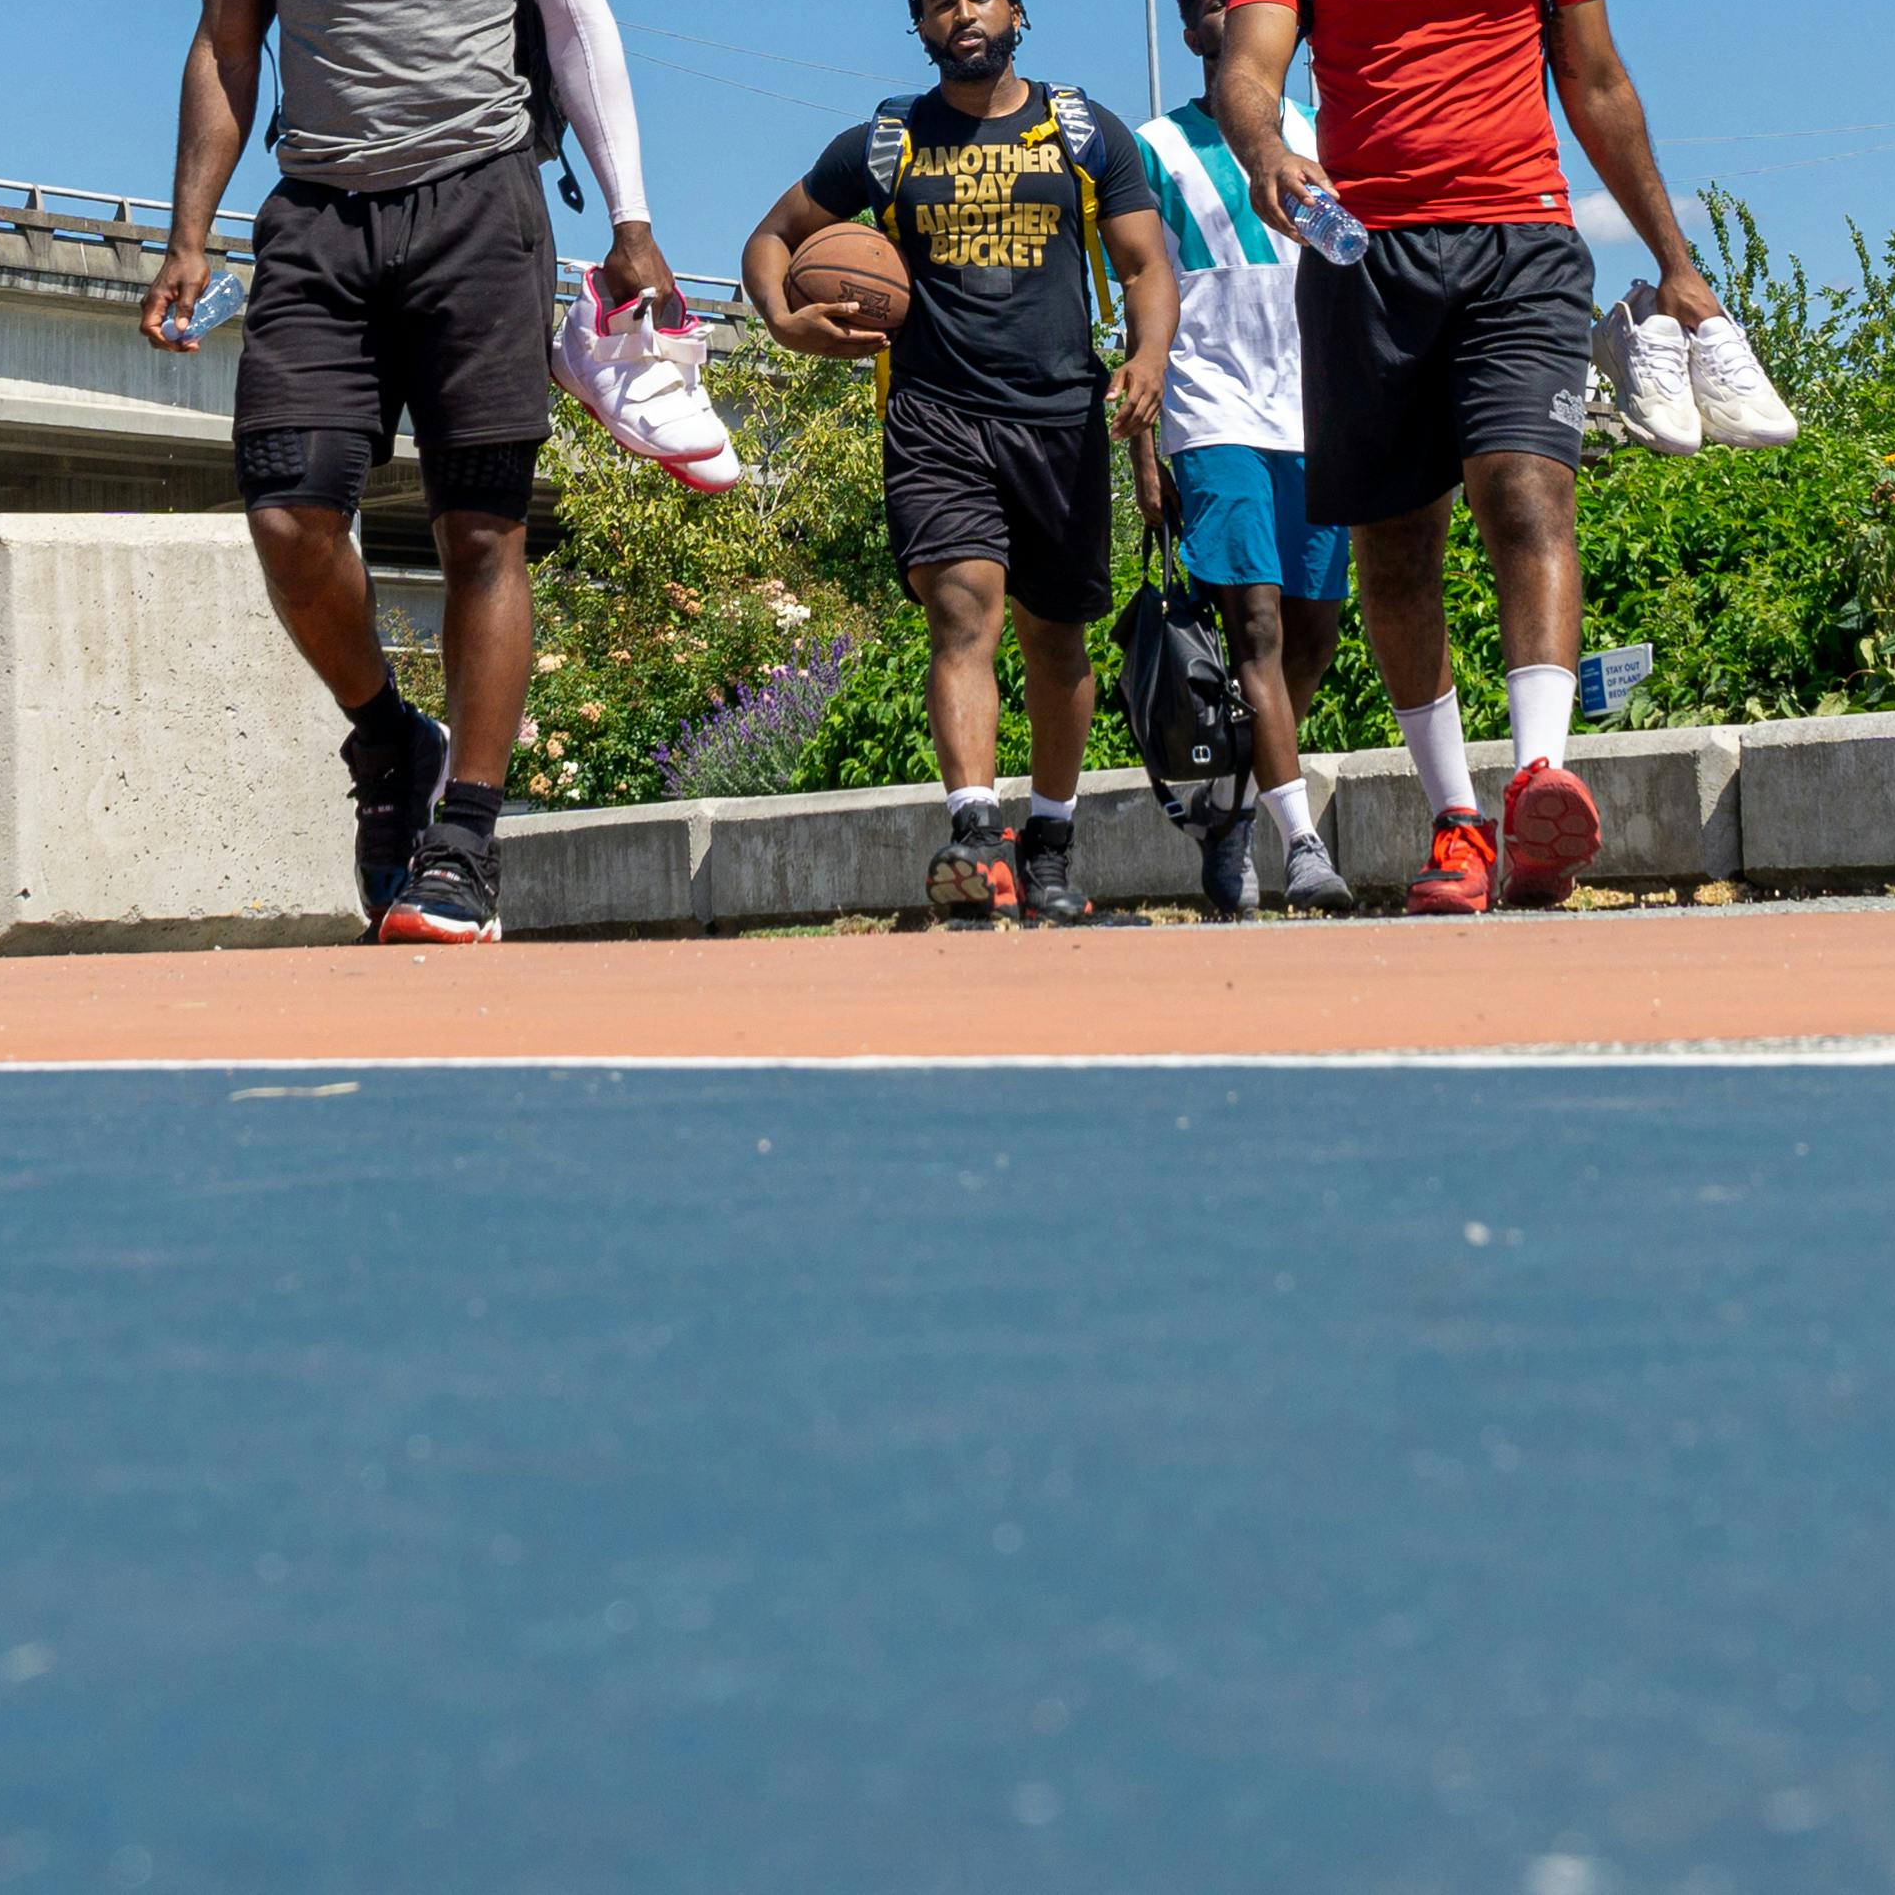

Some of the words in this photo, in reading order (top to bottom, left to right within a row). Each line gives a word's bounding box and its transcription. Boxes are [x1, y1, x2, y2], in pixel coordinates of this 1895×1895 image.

[911, 143, 1063, 176] ANOTHER
[955, 173, 1018, 204] DAY
[916, 202, 1062, 235] ANOTHER
[929, 234, 1047, 267] BUCKET
[1605, 665, 1623, 676] STAY
[1624, 661, 1639, 672] OUT
[1607, 677, 1617, 686] OF
[1618, 673, 1641, 684] PLANT
